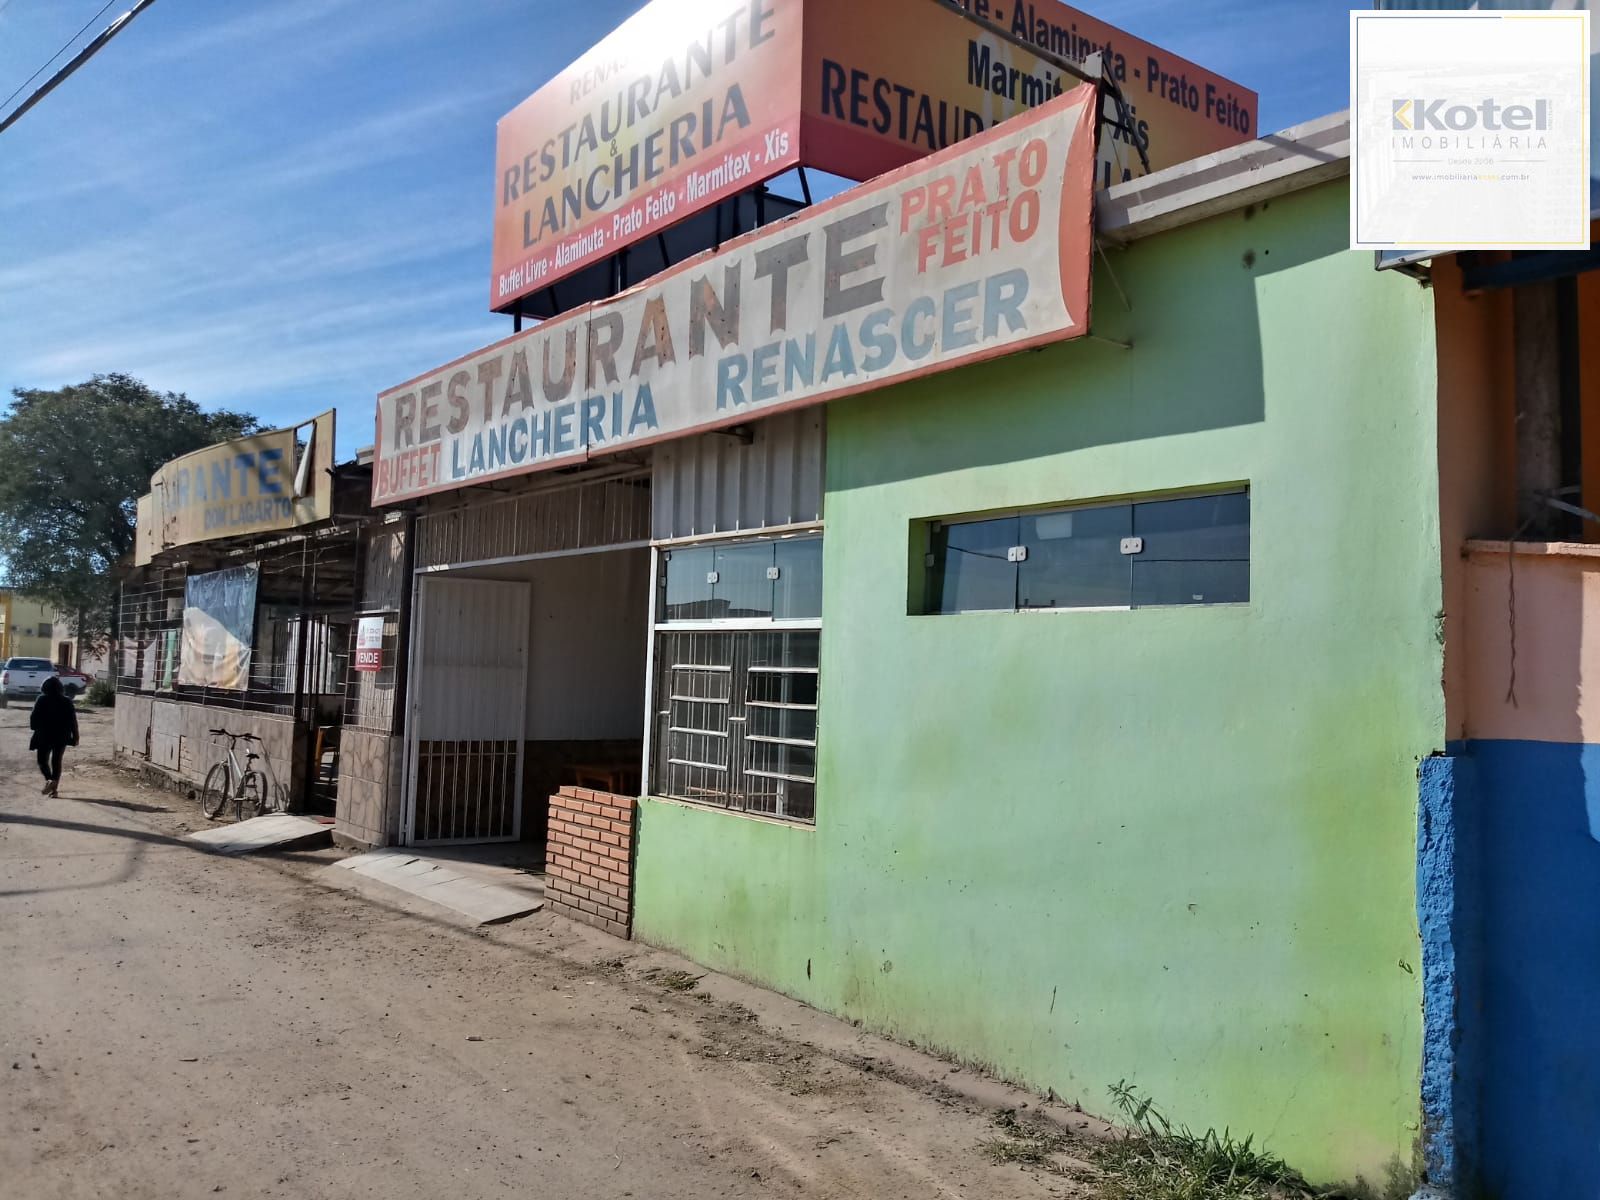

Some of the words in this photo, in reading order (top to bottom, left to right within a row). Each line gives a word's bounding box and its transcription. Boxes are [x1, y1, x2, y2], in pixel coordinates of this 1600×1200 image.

[502, 0, 777, 208] RESTAURANTE
[967, 39, 1064, 109] Marmit
[1011, 0, 1126, 83] Alaminta
[1147, 55, 1200, 113] Prato
[1205, 82, 1250, 135] Feito
[499, 268, 524, 298] Buffet
[525, 258, 548, 283] Livre
[554, 227, 605, 269] Alaminuta
[612, 208, 643, 241] Prato
[645, 190, 676, 225] Feito
[686, 150, 751, 204] Marmitex
[763, 128, 789, 165] Xis
[522, 82, 752, 250] LANCHERIA
[608, 138, 619, 157] &
[899, 137, 1049, 234] PRATO
[917, 188, 1041, 275] FEITO
[378, 442, 442, 498] BUFFET
[451, 382, 659, 480] LANCHERIA
[715, 267, 1030, 411] RENASCER
[393, 202, 889, 451] RESTAURANTE
